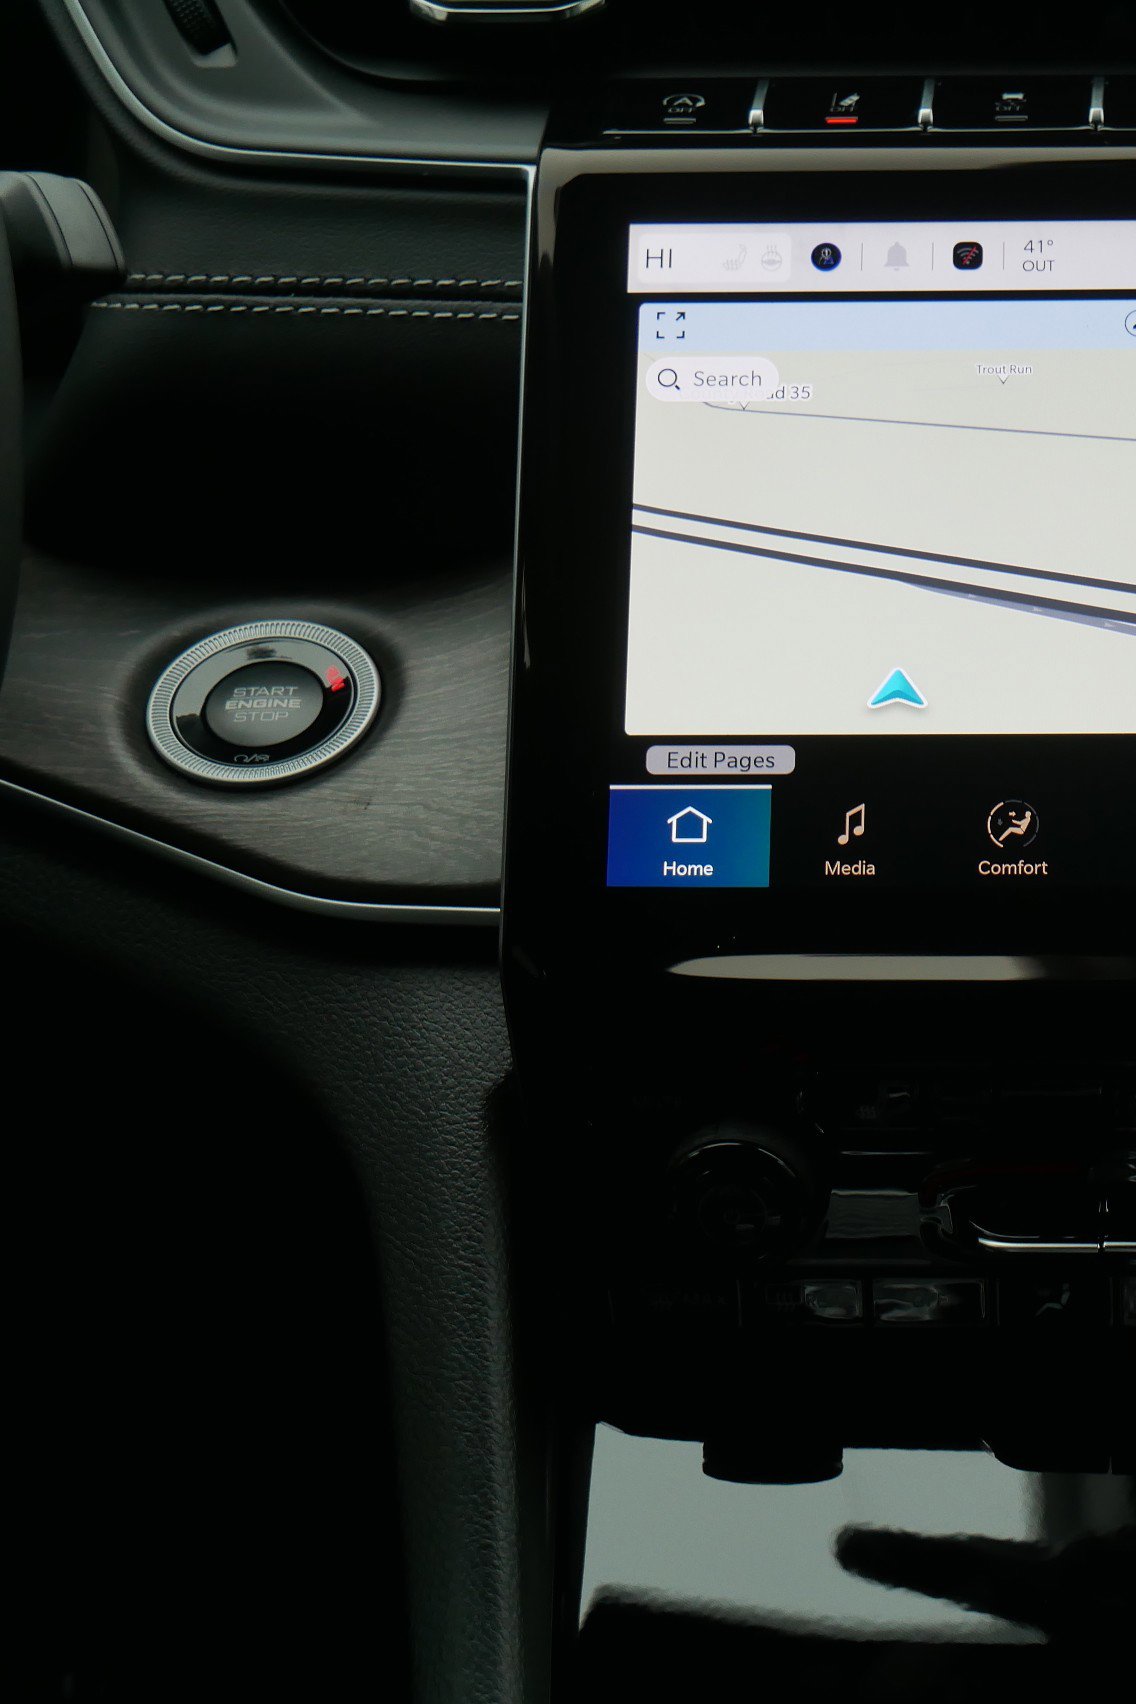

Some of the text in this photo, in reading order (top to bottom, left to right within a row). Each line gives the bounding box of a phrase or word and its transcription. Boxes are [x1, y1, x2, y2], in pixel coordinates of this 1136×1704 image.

[1023, 239, 1054, 254] 41°
[646, 248, 672, 268] HI
[1022, 259, 1055, 272] OUT
[976, 364, 1032, 374] Trout Run
[693, 370, 763, 388] Search
[790, 385, 811, 400] 35
[233, 686, 297, 697] START
[225, 699, 301, 710] ENGINE
[233, 711, 289, 722] STOP
[666, 751, 776, 773] Edit Pages
[662, 860, 714, 876] Home
[825, 860, 876, 876] Media
[978, 860, 1048, 875] Comfort
